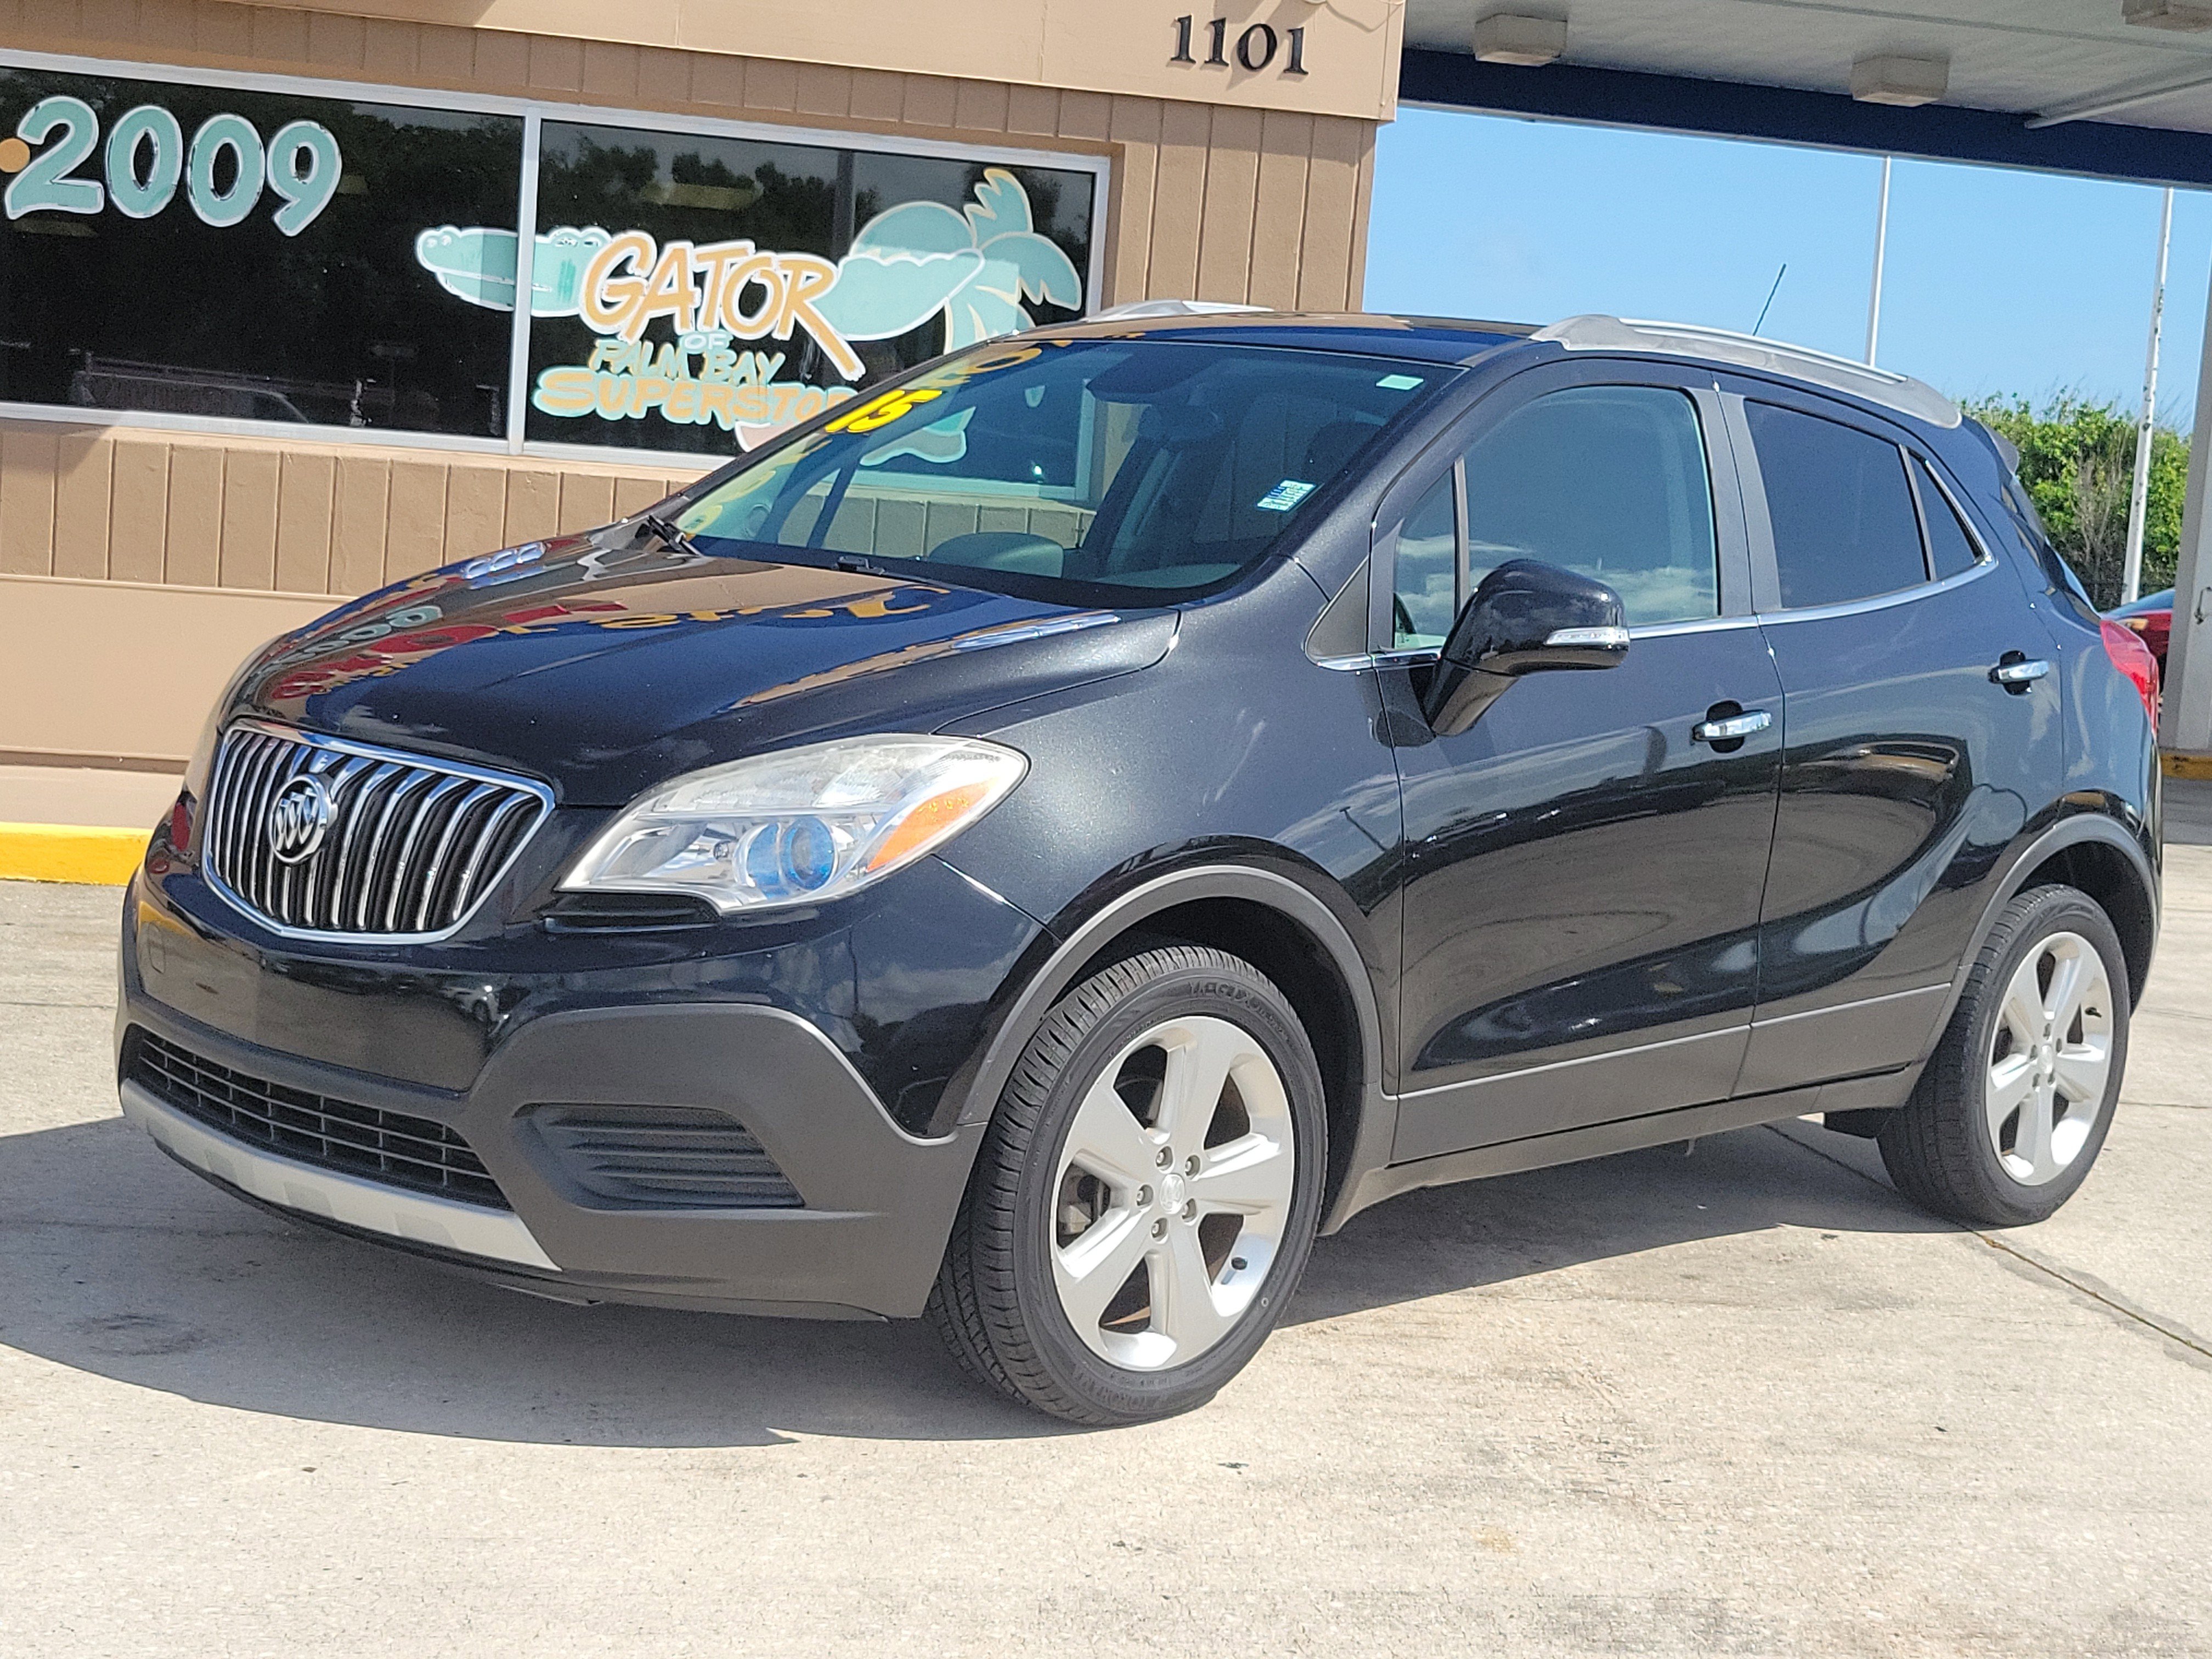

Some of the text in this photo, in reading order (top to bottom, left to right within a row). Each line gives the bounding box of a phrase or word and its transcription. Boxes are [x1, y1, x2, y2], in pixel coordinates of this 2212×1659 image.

[1170, 14, 1309, 75] 1101
[4, 95, 343, 237] 2009
[579, 230, 866, 381] GATOR
[589, 338, 786, 385] PALM BAY
[679, 330, 733, 355] OF
